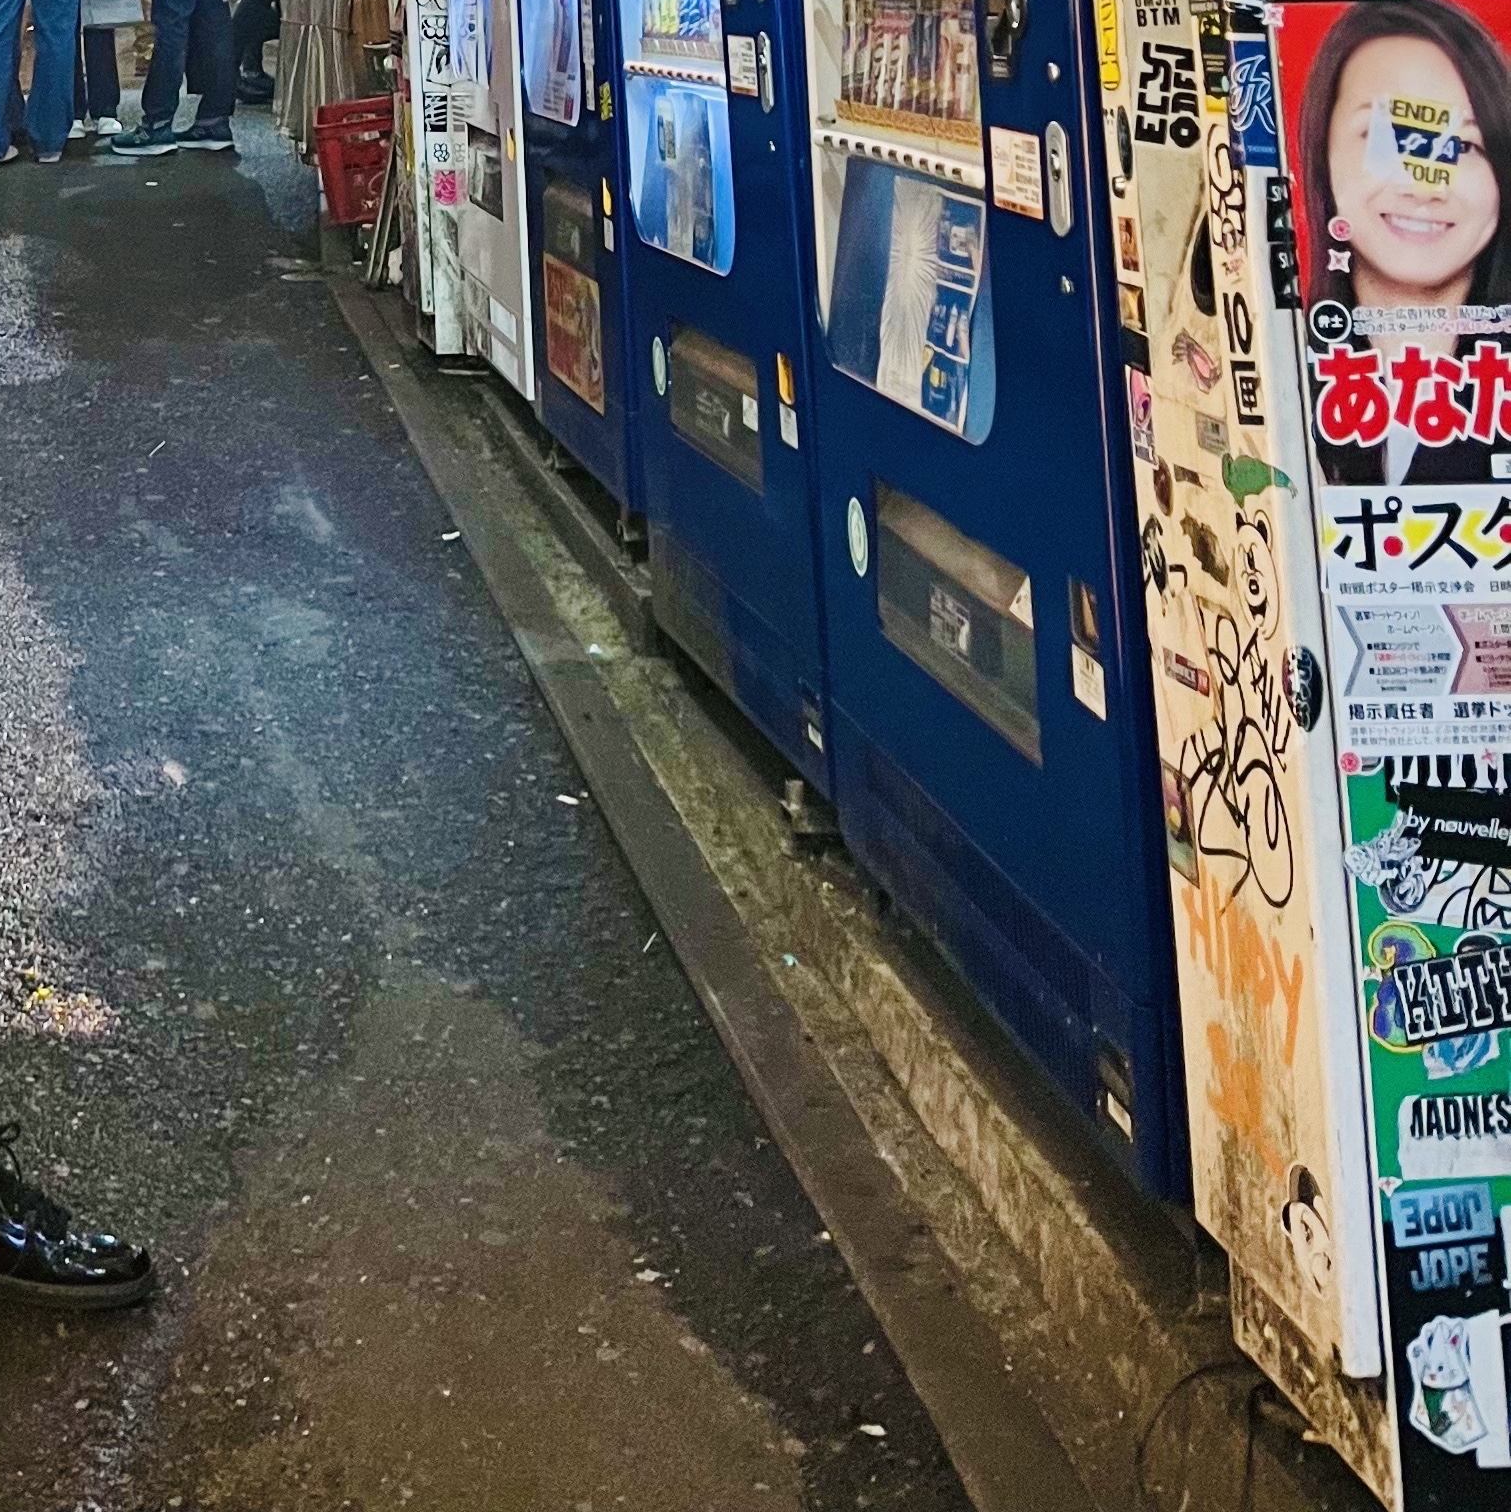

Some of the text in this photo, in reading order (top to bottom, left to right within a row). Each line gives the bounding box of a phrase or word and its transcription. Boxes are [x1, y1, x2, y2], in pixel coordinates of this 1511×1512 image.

[1136, 7, 1181, 28] BTM
[1349, 701, 1434, 720] 掲示責任者
[1407, 808, 1430, 834] by
